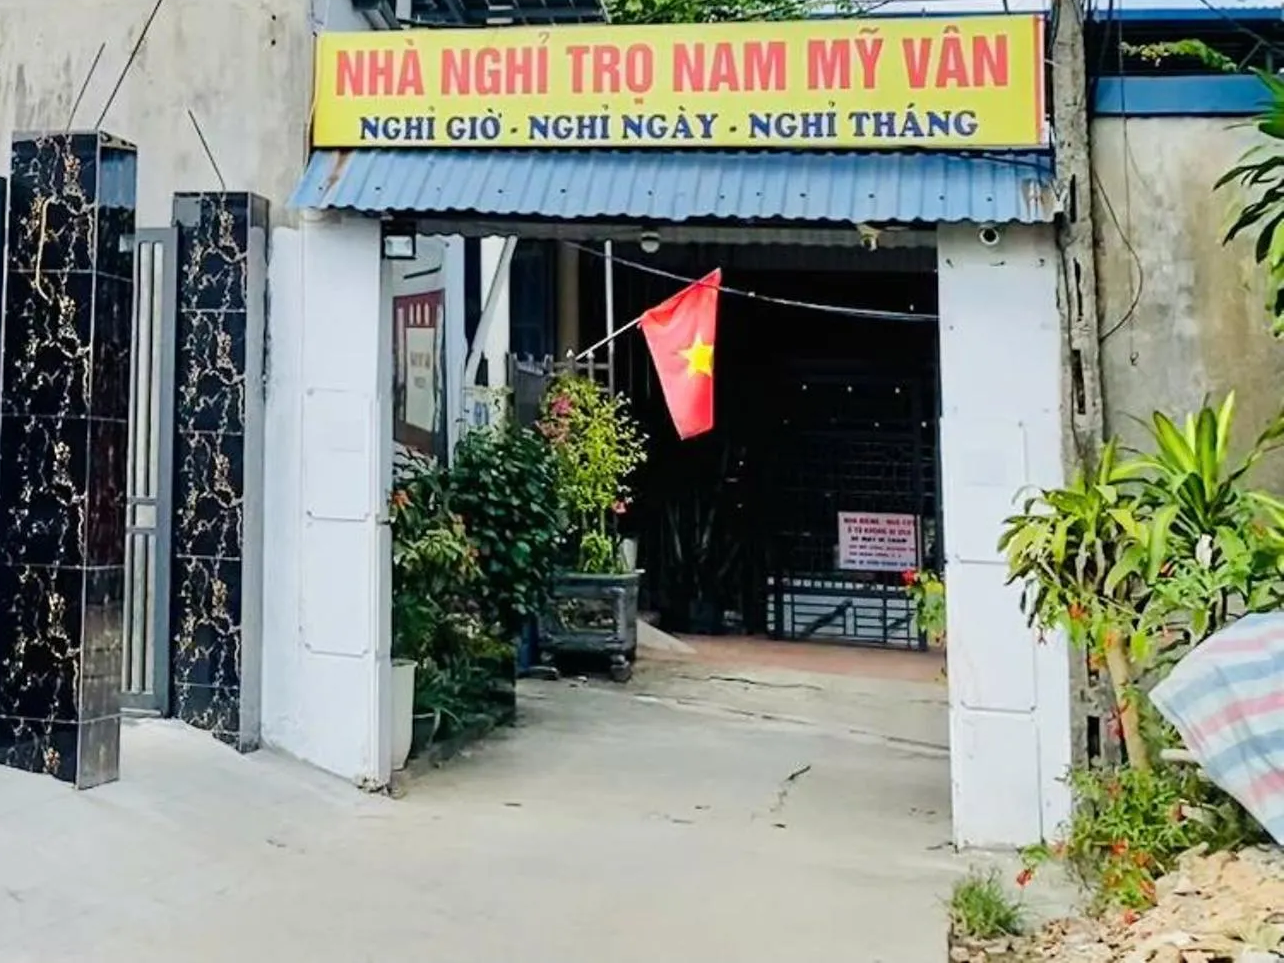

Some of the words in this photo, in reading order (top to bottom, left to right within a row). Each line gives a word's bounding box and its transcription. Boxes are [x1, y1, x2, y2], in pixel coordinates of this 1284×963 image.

[335, 38, 424, 96] NHÀ
[440, 32, 549, 95] NGHỈ
[566, 45, 653, 104] TRỌ
[672, 42, 787, 93] NAM
[807, 27, 884, 90] MỸ
[902, 25, 1009, 88] VÂN
[359, 105, 436, 141] NGHỈ
[445, 108, 503, 141] GIỜ
[528, 104, 611, 140] NGHỈ
[621, 105, 719, 140] NGÀY
[748, 101, 838, 139] NGHỈ
[847, 102, 978, 138] THÁNG
